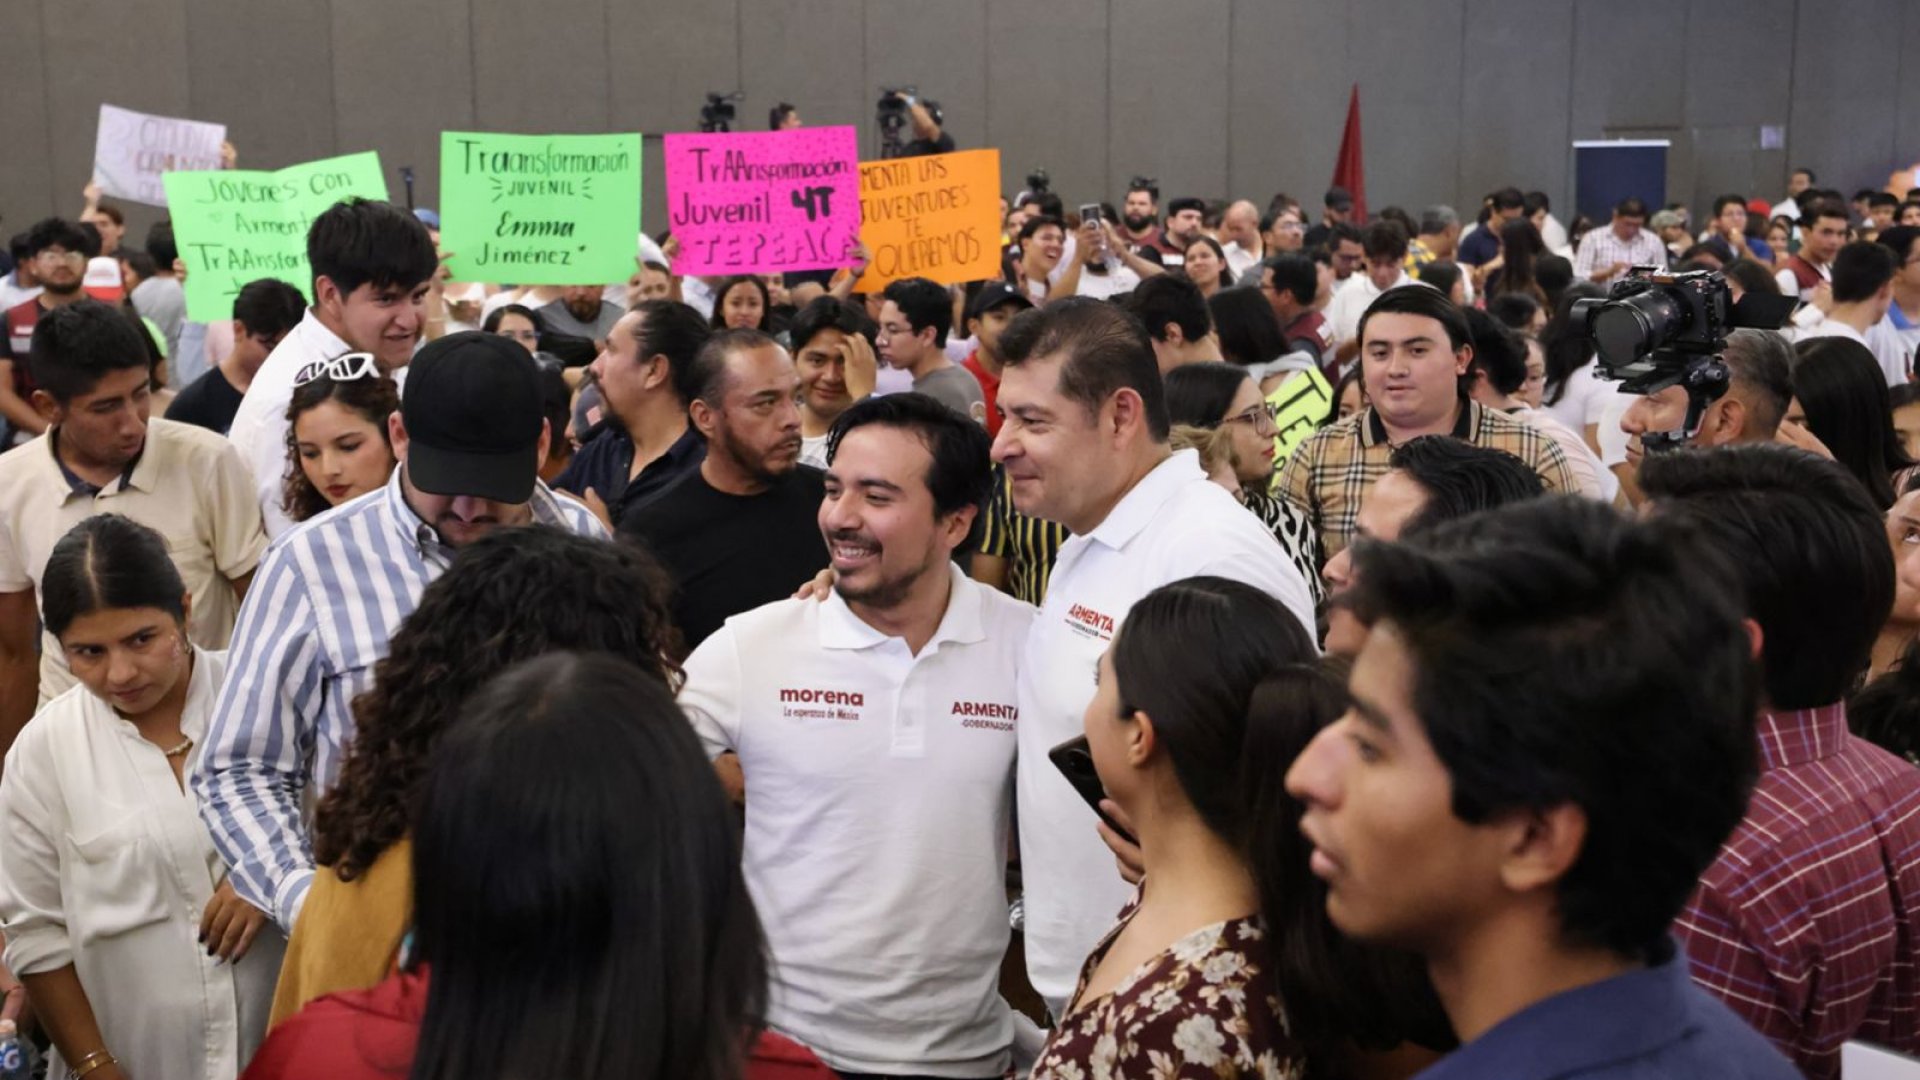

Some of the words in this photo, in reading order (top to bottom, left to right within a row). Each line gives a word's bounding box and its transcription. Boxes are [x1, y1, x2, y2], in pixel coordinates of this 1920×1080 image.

[508, 180, 575, 196] JUVENIL
[859, 161, 911, 191] MENTA
[918, 157, 948, 182] LAS
[674, 192, 771, 226] Juvenil
[791, 186, 836, 222] 4T
[859, 184, 971, 226] JUVENTUDES
[235, 211, 313, 236] Arment
[496, 210, 576, 238] Emma
[904, 217, 923, 238] TE
[475, 242, 573, 266] Jiménez
[876, 227, 980, 278] QUEREMOS
[1068, 603, 1114, 633] ARMENTA
[780, 689, 864, 707] morena
